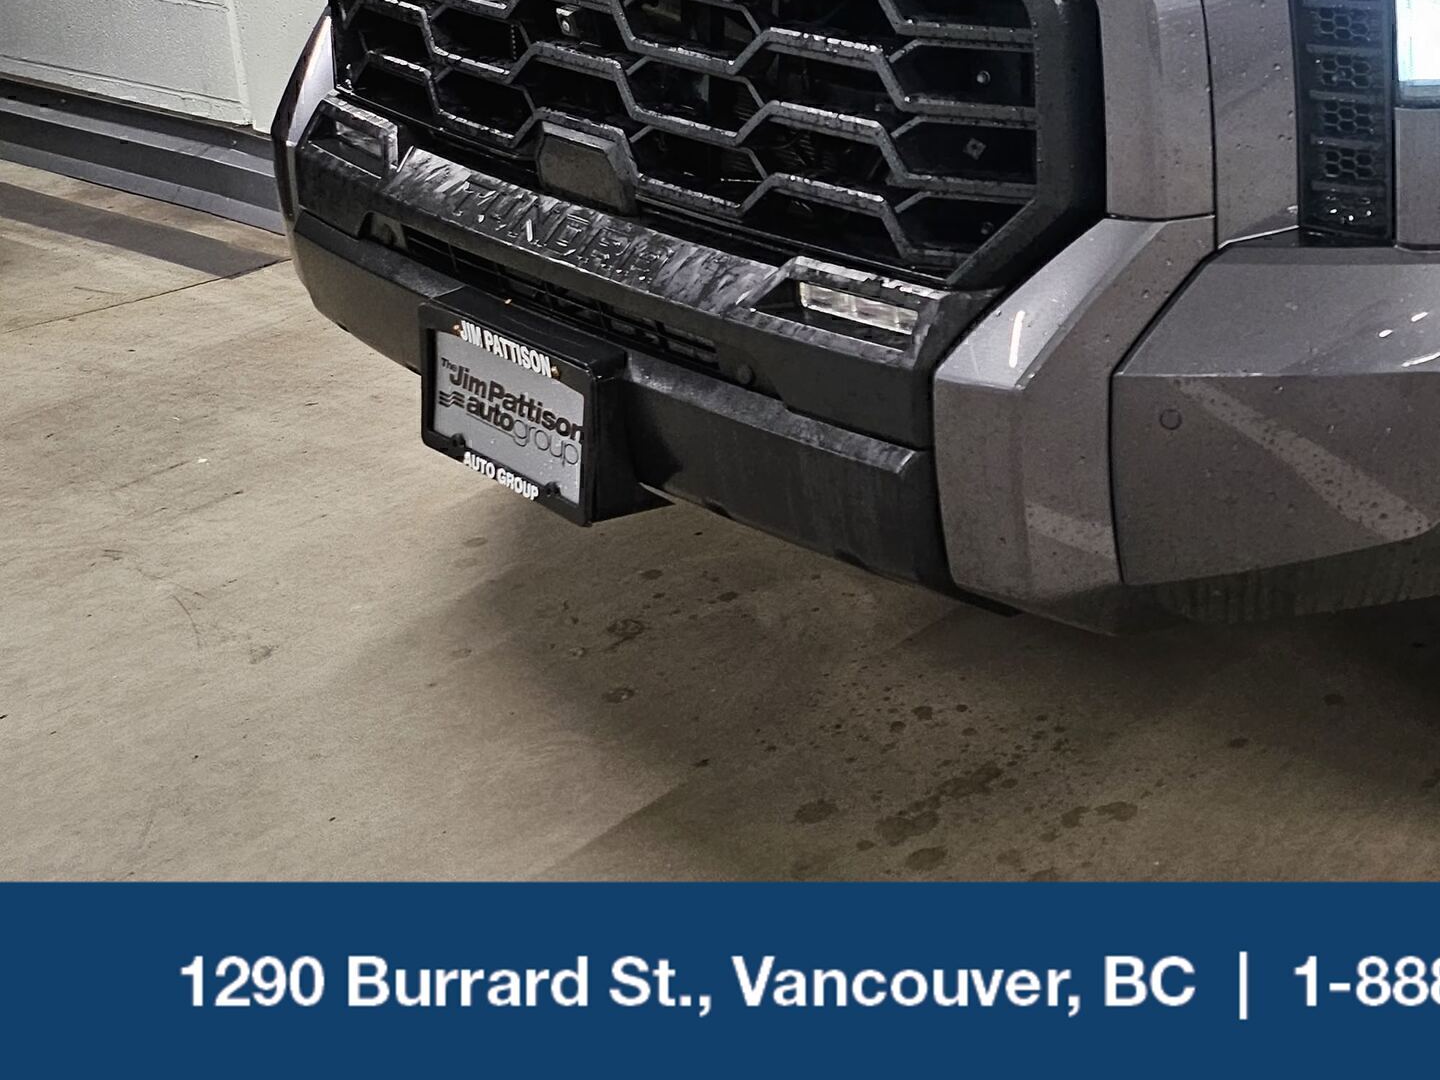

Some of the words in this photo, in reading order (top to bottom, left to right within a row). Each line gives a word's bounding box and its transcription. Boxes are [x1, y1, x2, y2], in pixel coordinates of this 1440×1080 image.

[441, 356, 458, 372] The
[459, 319, 484, 350] JIM
[485, 329, 553, 378] PATTISON
[463, 451, 496, 479] AUTO
[496, 467, 540, 501] GROUP
